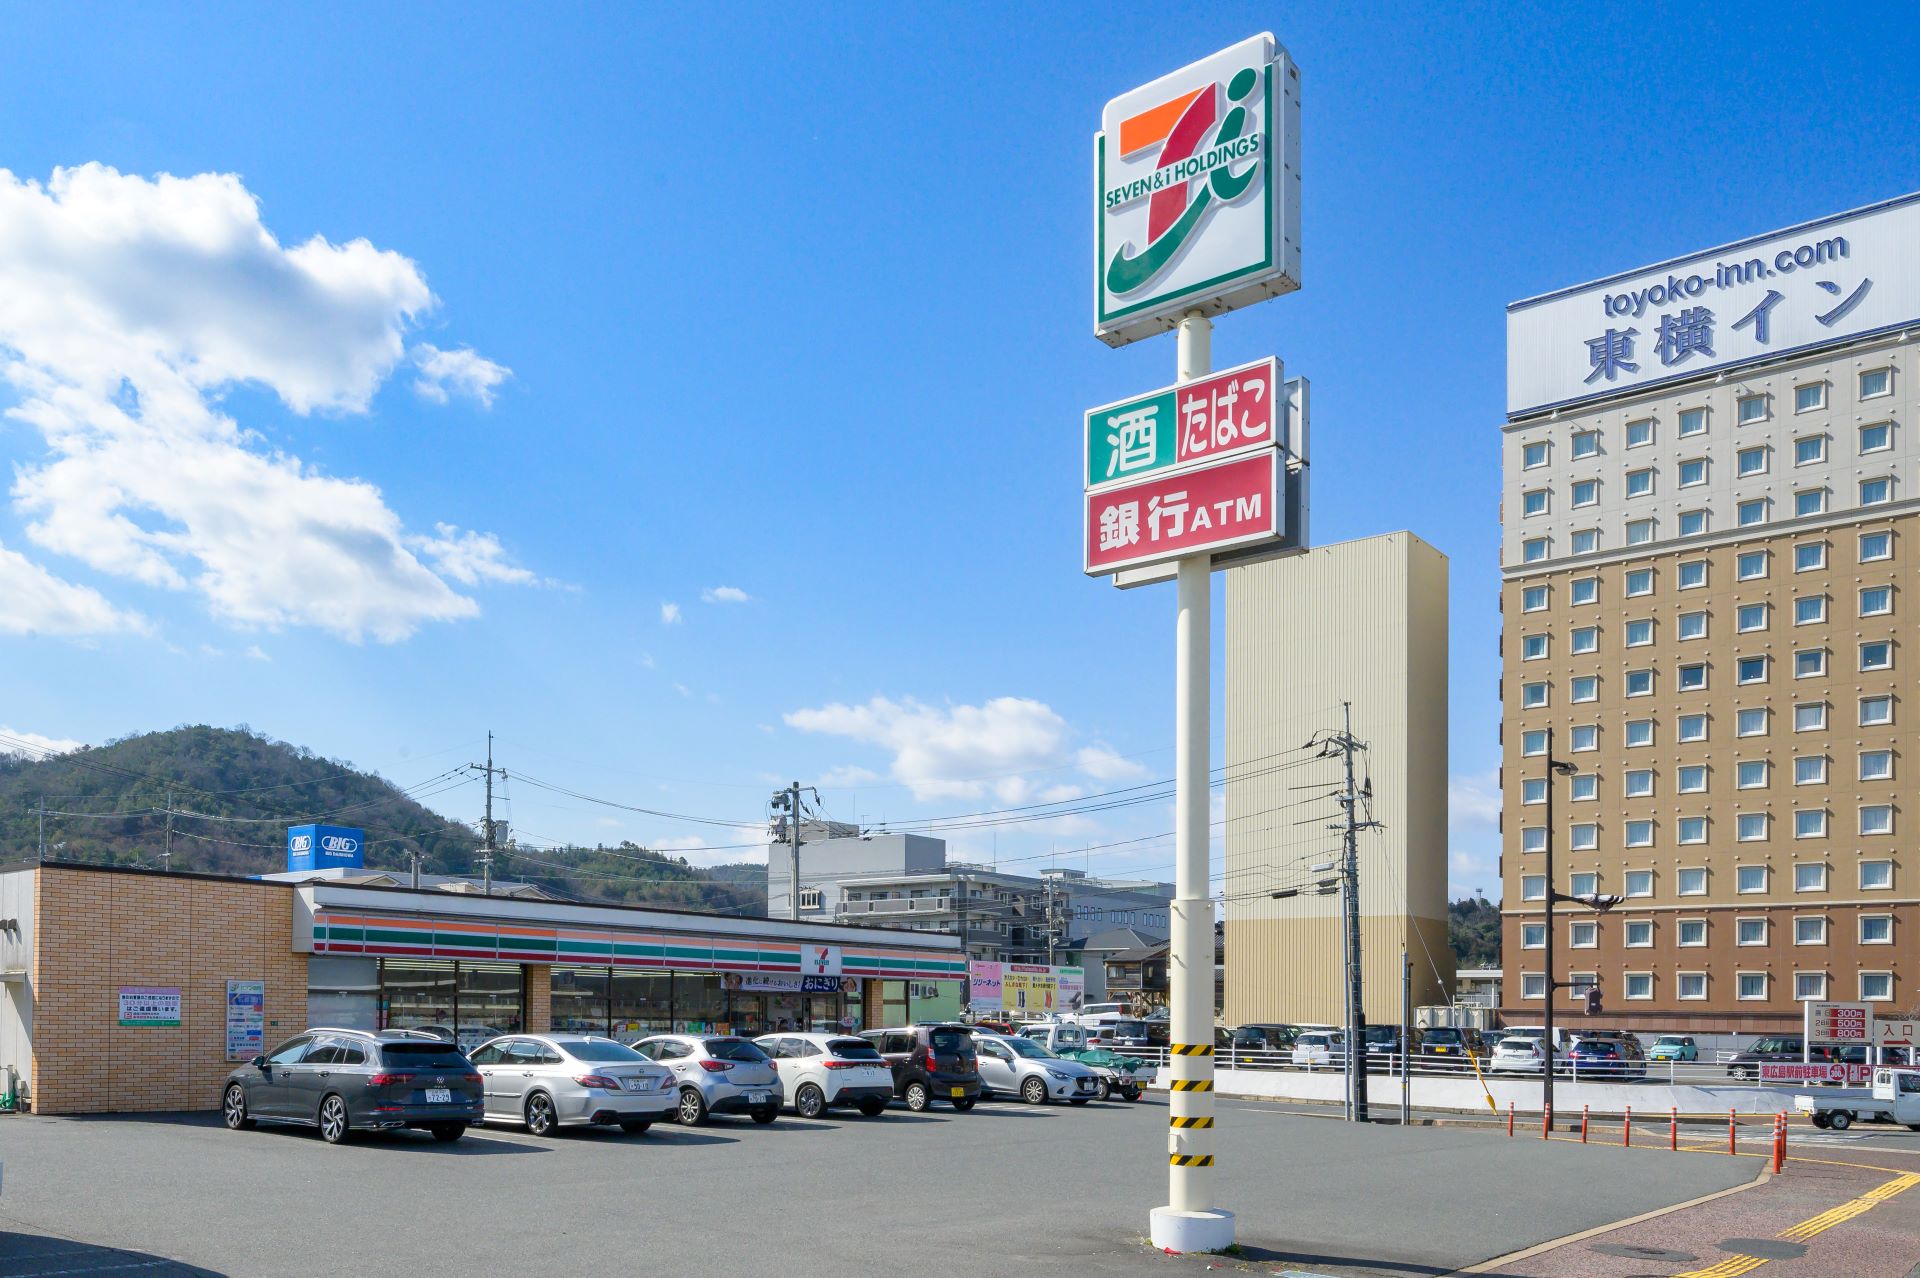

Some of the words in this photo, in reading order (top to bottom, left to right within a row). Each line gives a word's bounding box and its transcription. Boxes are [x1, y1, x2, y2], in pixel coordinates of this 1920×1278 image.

[1175, 133, 1259, 182] HOLDINGS
[1603, 236, 1847, 317] toyoko-inn.com
[1583, 278, 1870, 384] 東横イン
[1181, 378, 1267, 457] たばこ
[1107, 405, 1159, 477] 酒
[1100, 491, 1262, 552] 銀行ATM
[294, 836, 308, 849] BIG
[328, 837, 350, 850] BIG
[815, 947, 829, 973] 7
[804, 976, 838, 990] おにぎり
[1837, 1009, 1862, 1018] 300円
[1837, 1019, 1862, 1028] 500円
[1884, 1024, 1913, 1037] 入口
[1837, 1029, 1862, 1038] 800円
[1761, 1064, 1828, 1079] 東広島駅前駐車場
[1860, 1067, 1871, 1081] P
